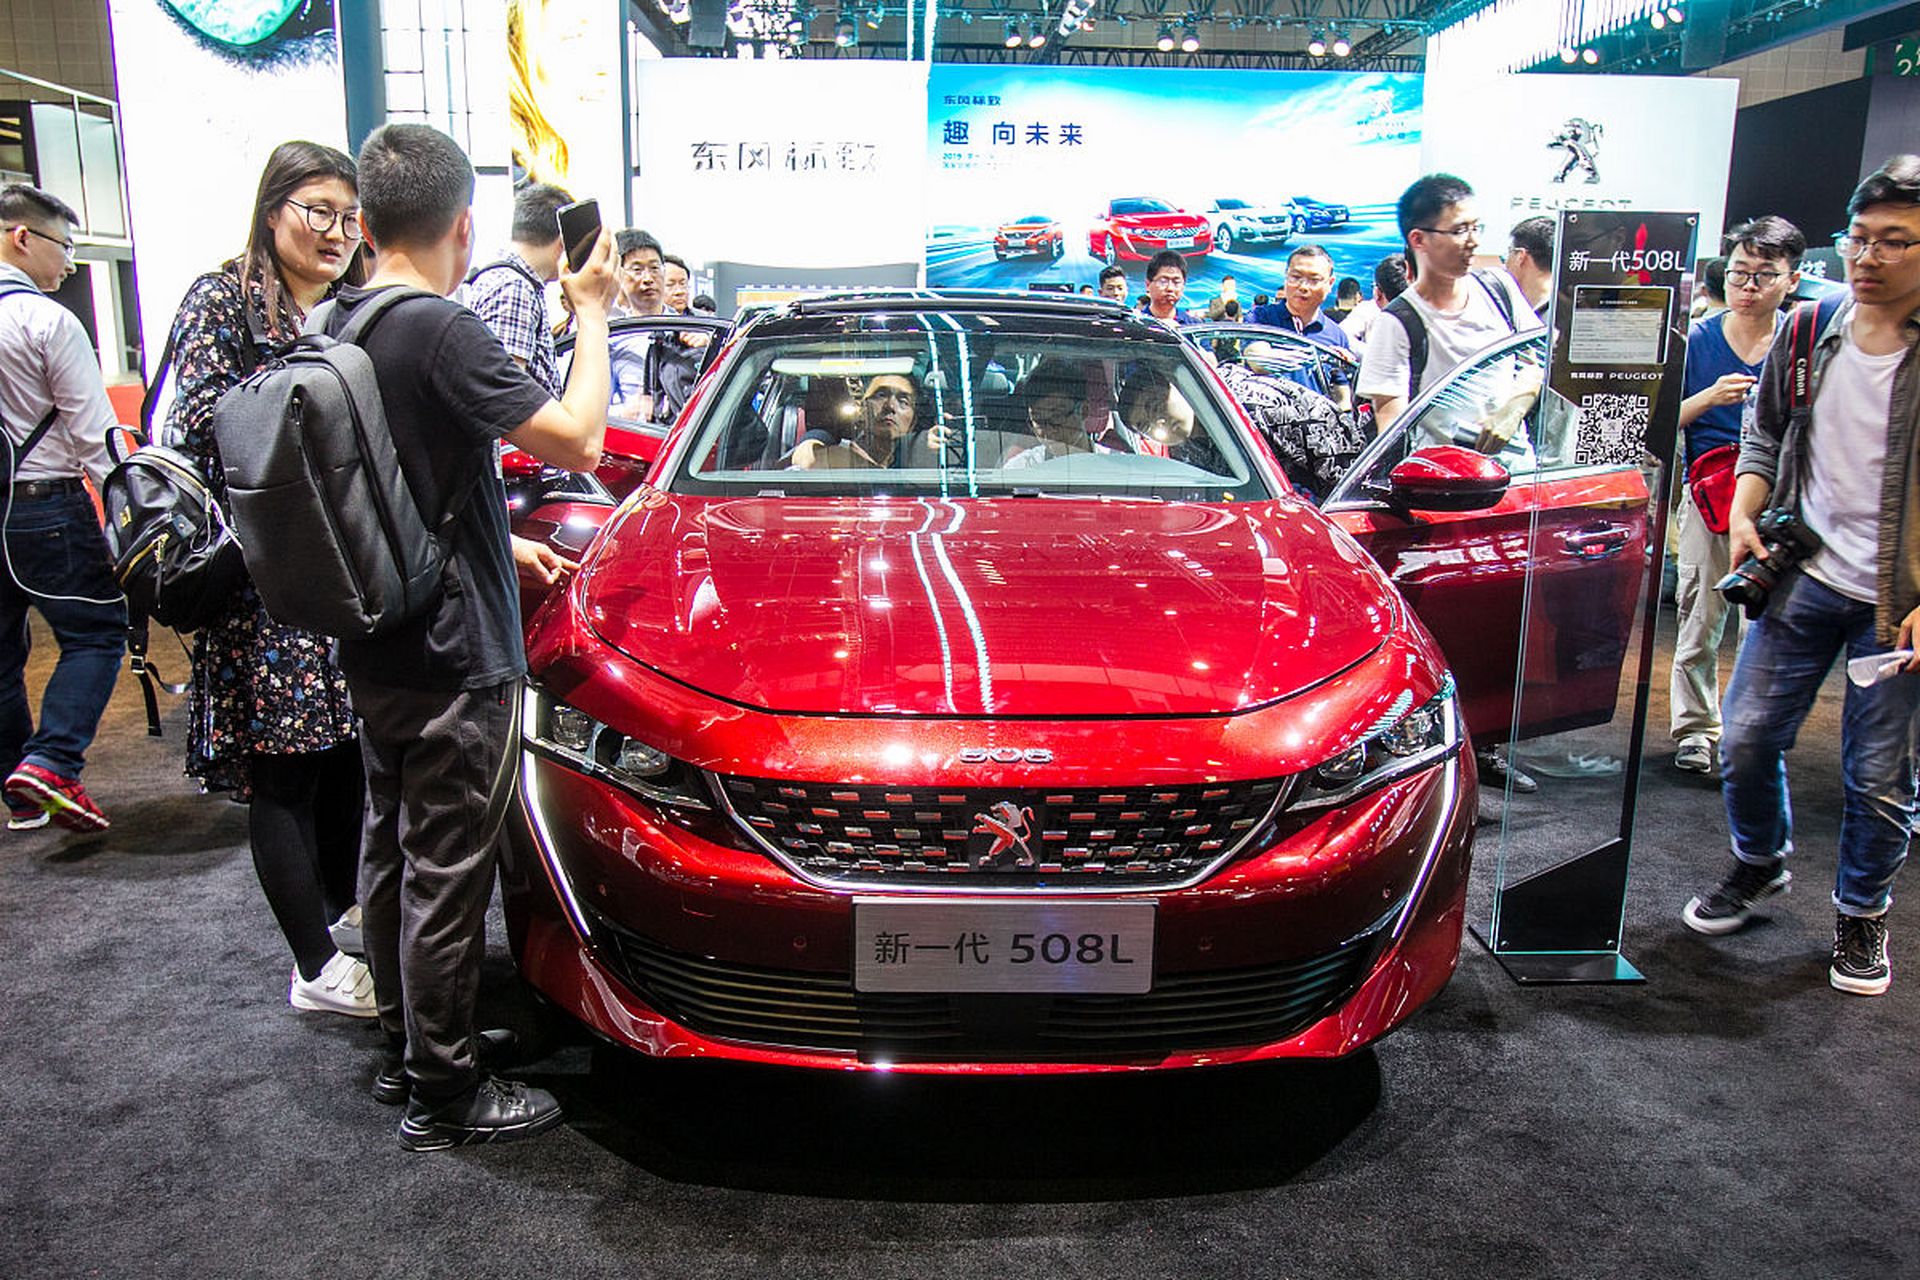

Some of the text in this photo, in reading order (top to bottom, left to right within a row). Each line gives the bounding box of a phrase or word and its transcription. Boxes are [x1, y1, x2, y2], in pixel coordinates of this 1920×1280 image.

[1569, 250, 1687, 272] 新一代508L
[1609, 372, 1664, 380] PEUGEOT
[1796, 357, 1807, 396] Canon
[960, 747, 1053, 763] 508
[875, 932, 1134, 965] 新一代 508L
